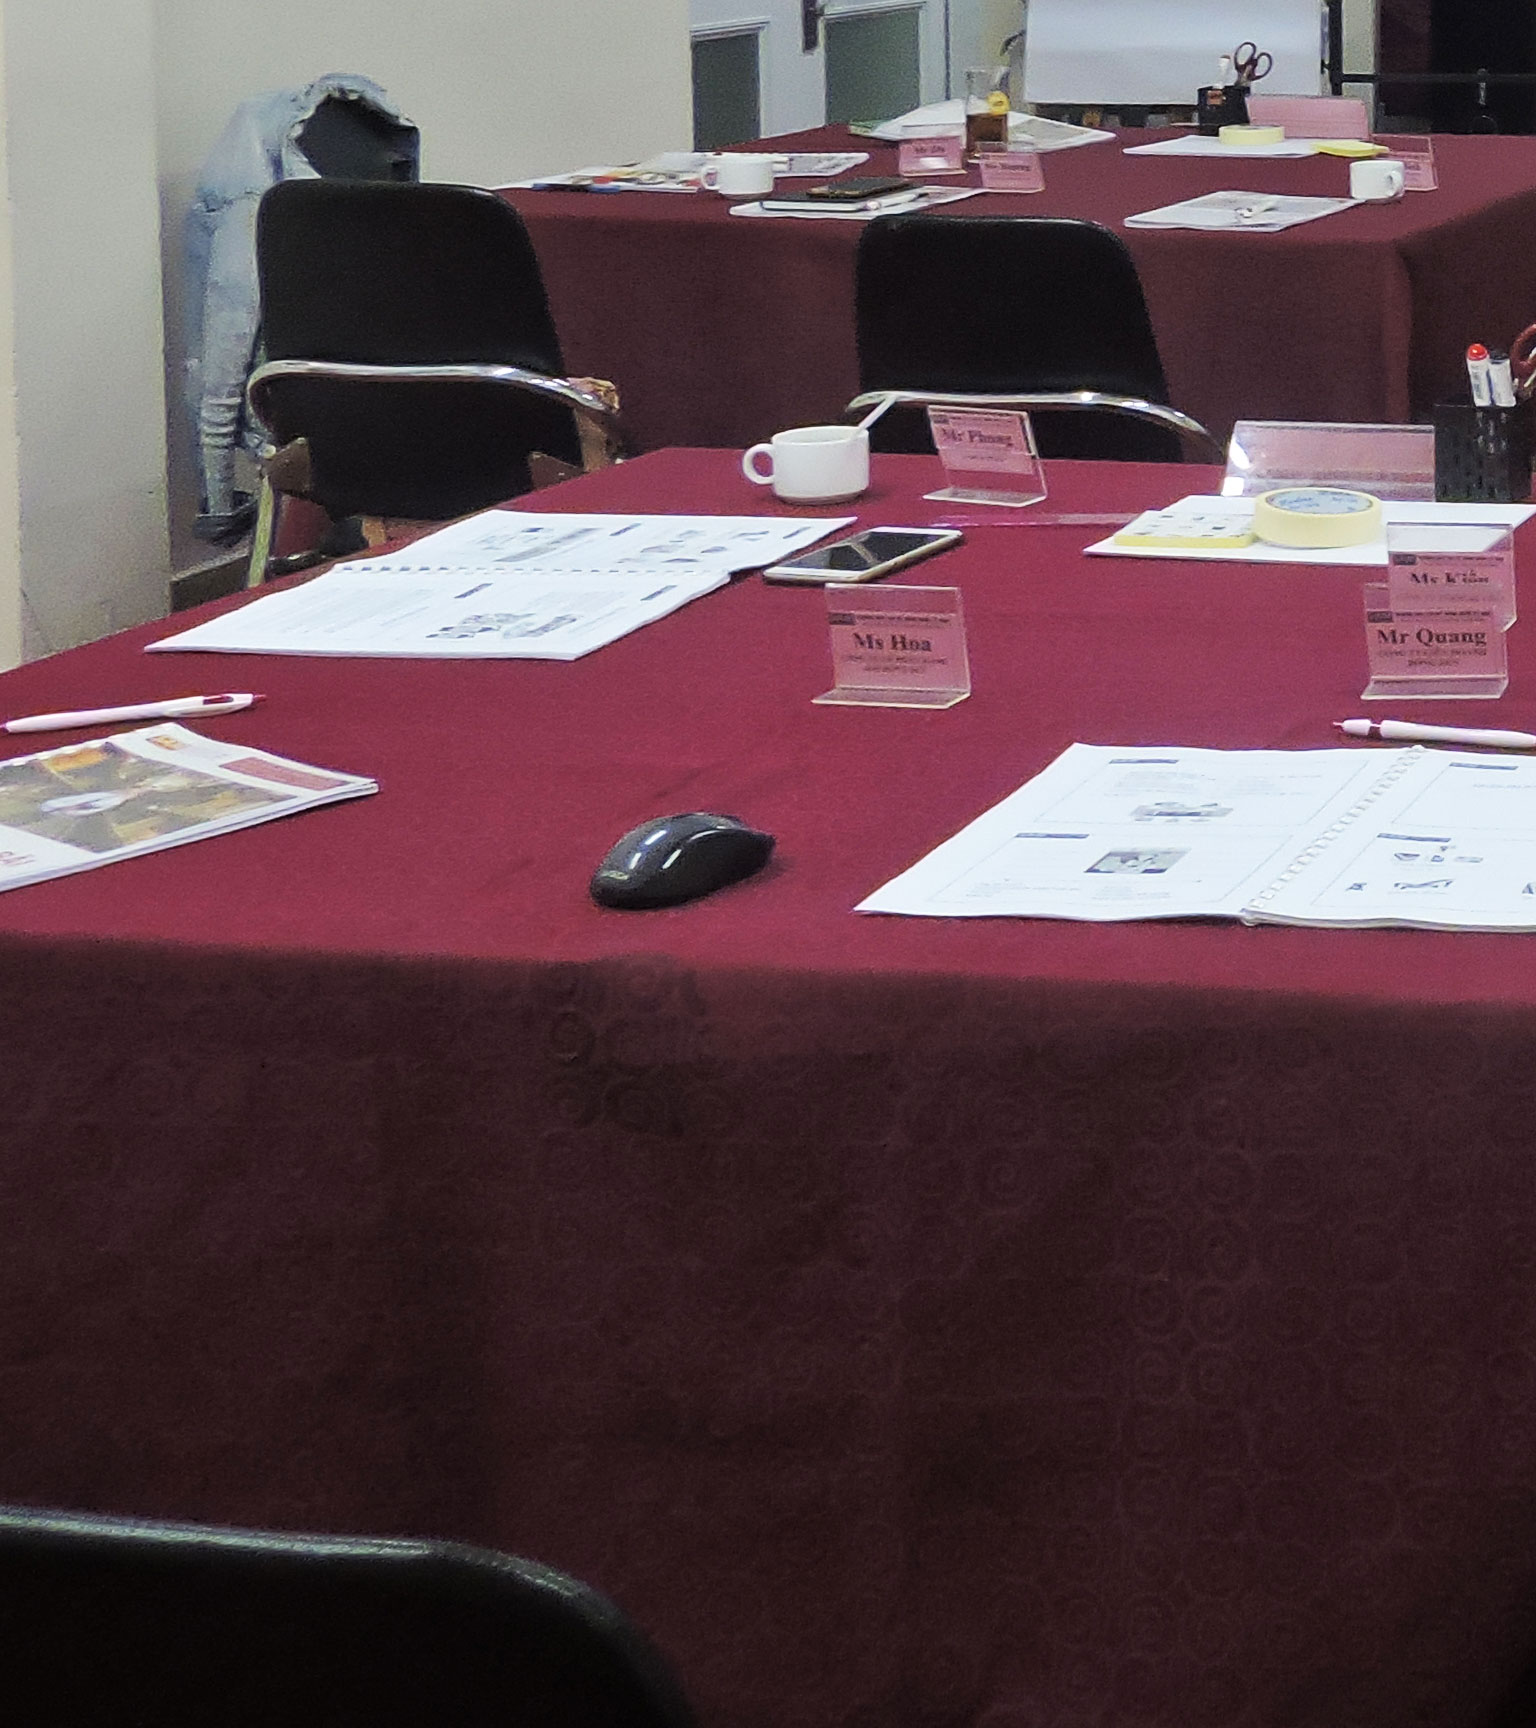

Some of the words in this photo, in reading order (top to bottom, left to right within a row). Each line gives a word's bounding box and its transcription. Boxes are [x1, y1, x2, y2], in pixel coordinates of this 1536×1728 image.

[853, 632, 884, 650] Ms
[890, 633, 933, 653] Hoa
[1376, 628, 1410, 645] Mr
[1416, 627, 1488, 648] Quang
